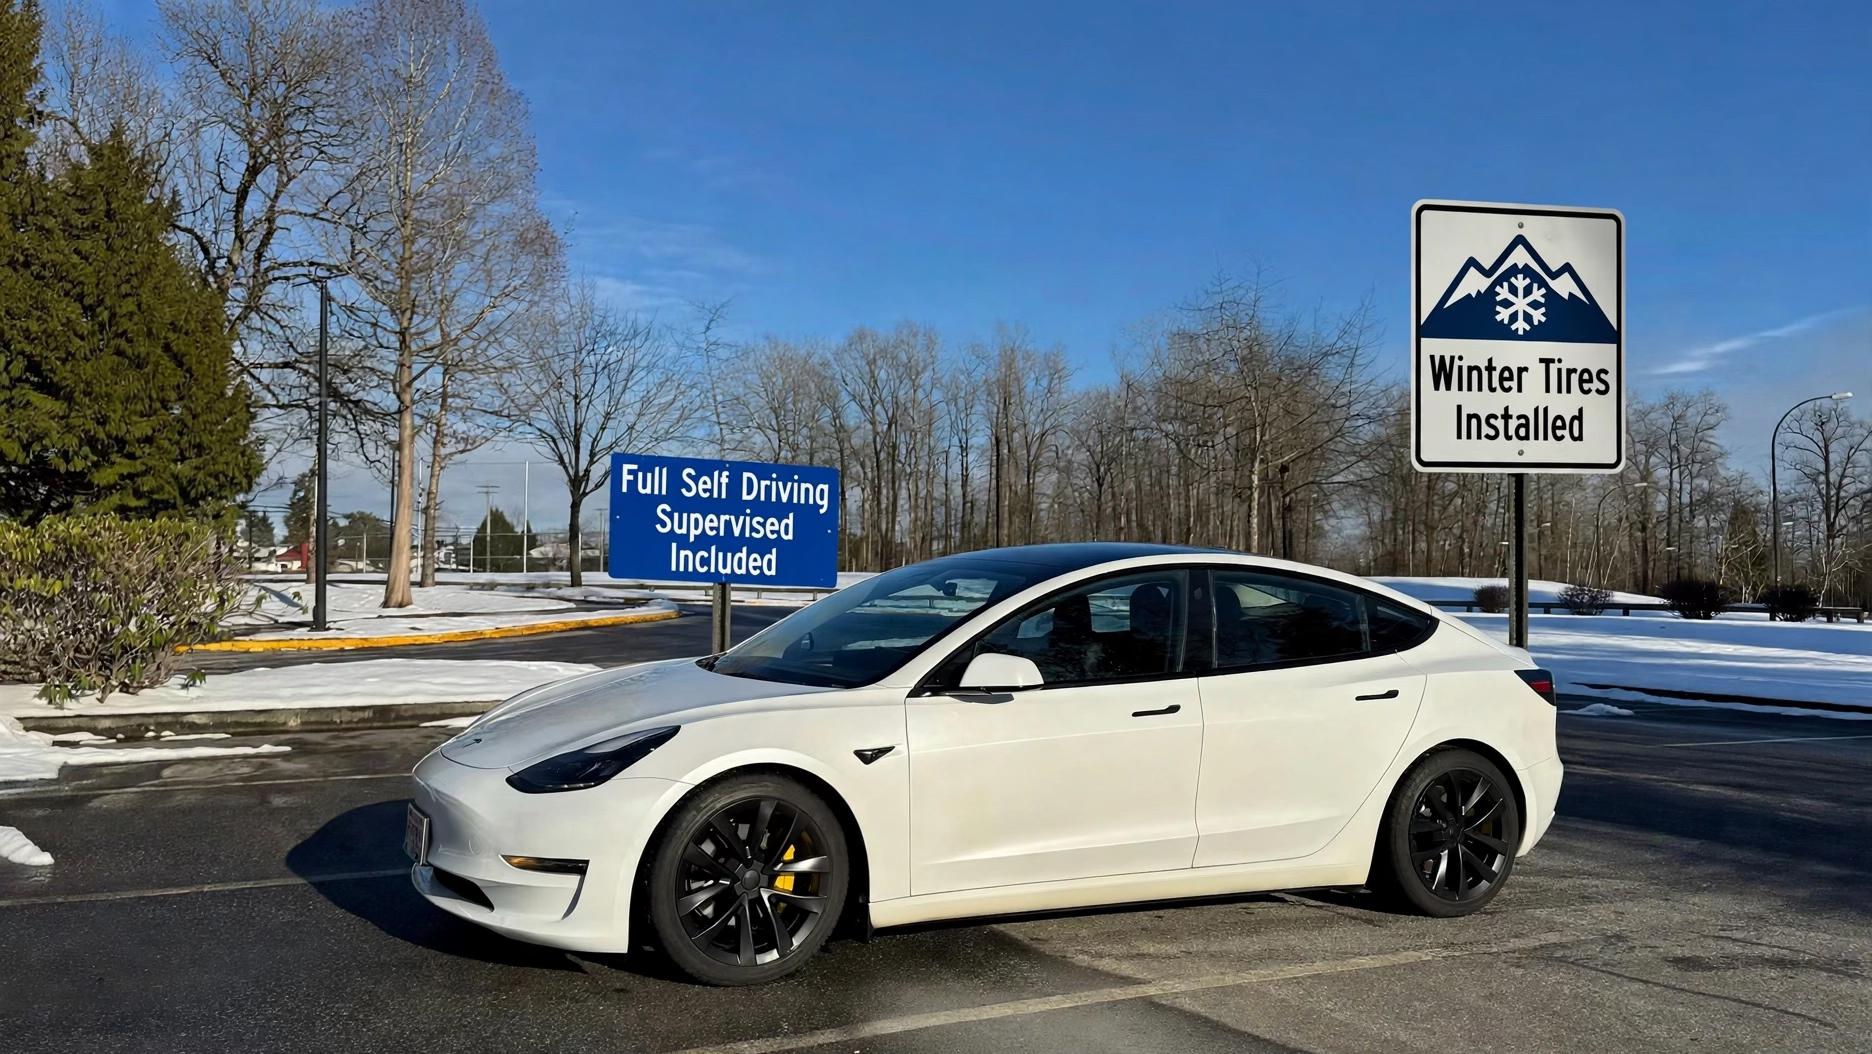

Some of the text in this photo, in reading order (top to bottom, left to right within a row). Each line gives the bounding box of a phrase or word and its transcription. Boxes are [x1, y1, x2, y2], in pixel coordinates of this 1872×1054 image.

[1429, 354, 1611, 396] Winter Tires
[1456, 404, 1584, 442] Installed
[621, 463, 829, 514] Full Self Driving
[655, 503, 794, 543] Supervised
[671, 542, 777, 576] Included
